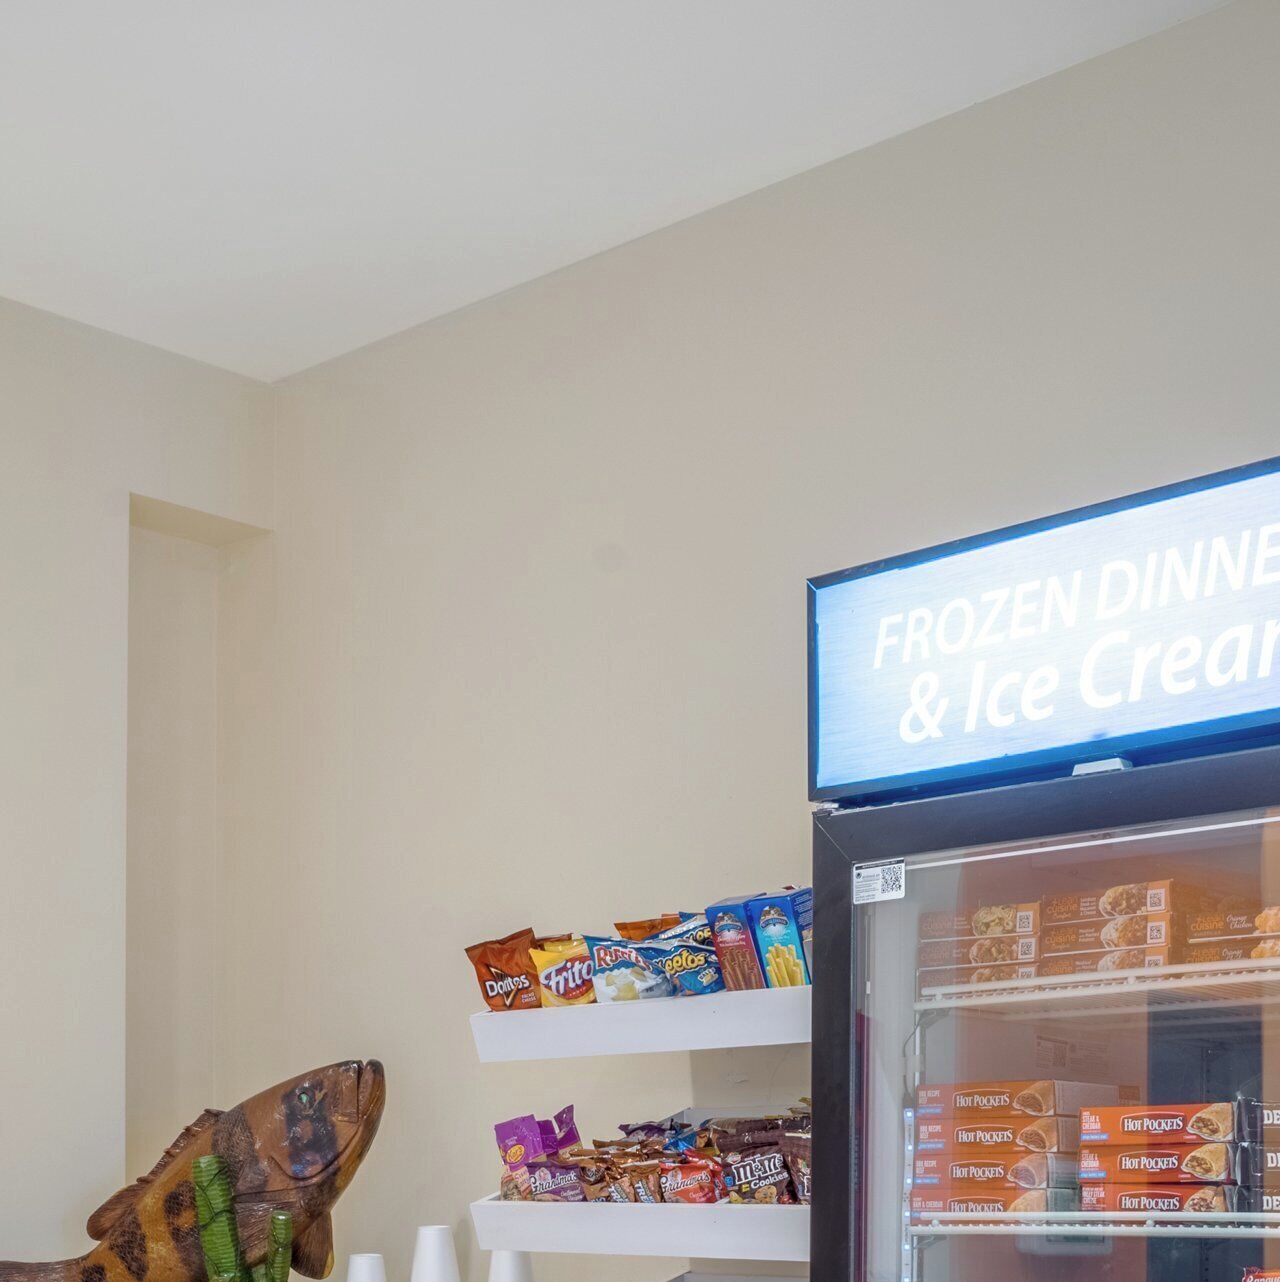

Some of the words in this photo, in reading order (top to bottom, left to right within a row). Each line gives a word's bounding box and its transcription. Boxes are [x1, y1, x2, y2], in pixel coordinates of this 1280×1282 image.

[873, 568, 1083, 670] FROZEN
[899, 671, 948, 743] &
[964, 660, 1061, 733] Ice
[484, 973, 531, 998] Doritos
[956, 1095, 972, 1107] HOT
[973, 1093, 1010, 1107] POCKETS
[1123, 1118, 1142, 1131] HOT
[1143, 1116, 1184, 1131] POCKETS
[958, 1130, 974, 1144] HOT
[975, 1129, 1014, 1143] POCKETS
[1121, 1156, 1138, 1170] HOT
[1138, 1155, 1179, 1169] POCKETS
[952, 1166, 968, 1178] HOT
[969, 1165, 1004, 1178] POCKETS
[750, 1171, 790, 1190] Cookies
[1121, 1197, 1138, 1210] HOT
[1139, 1196, 1180, 1211] POCKETS
